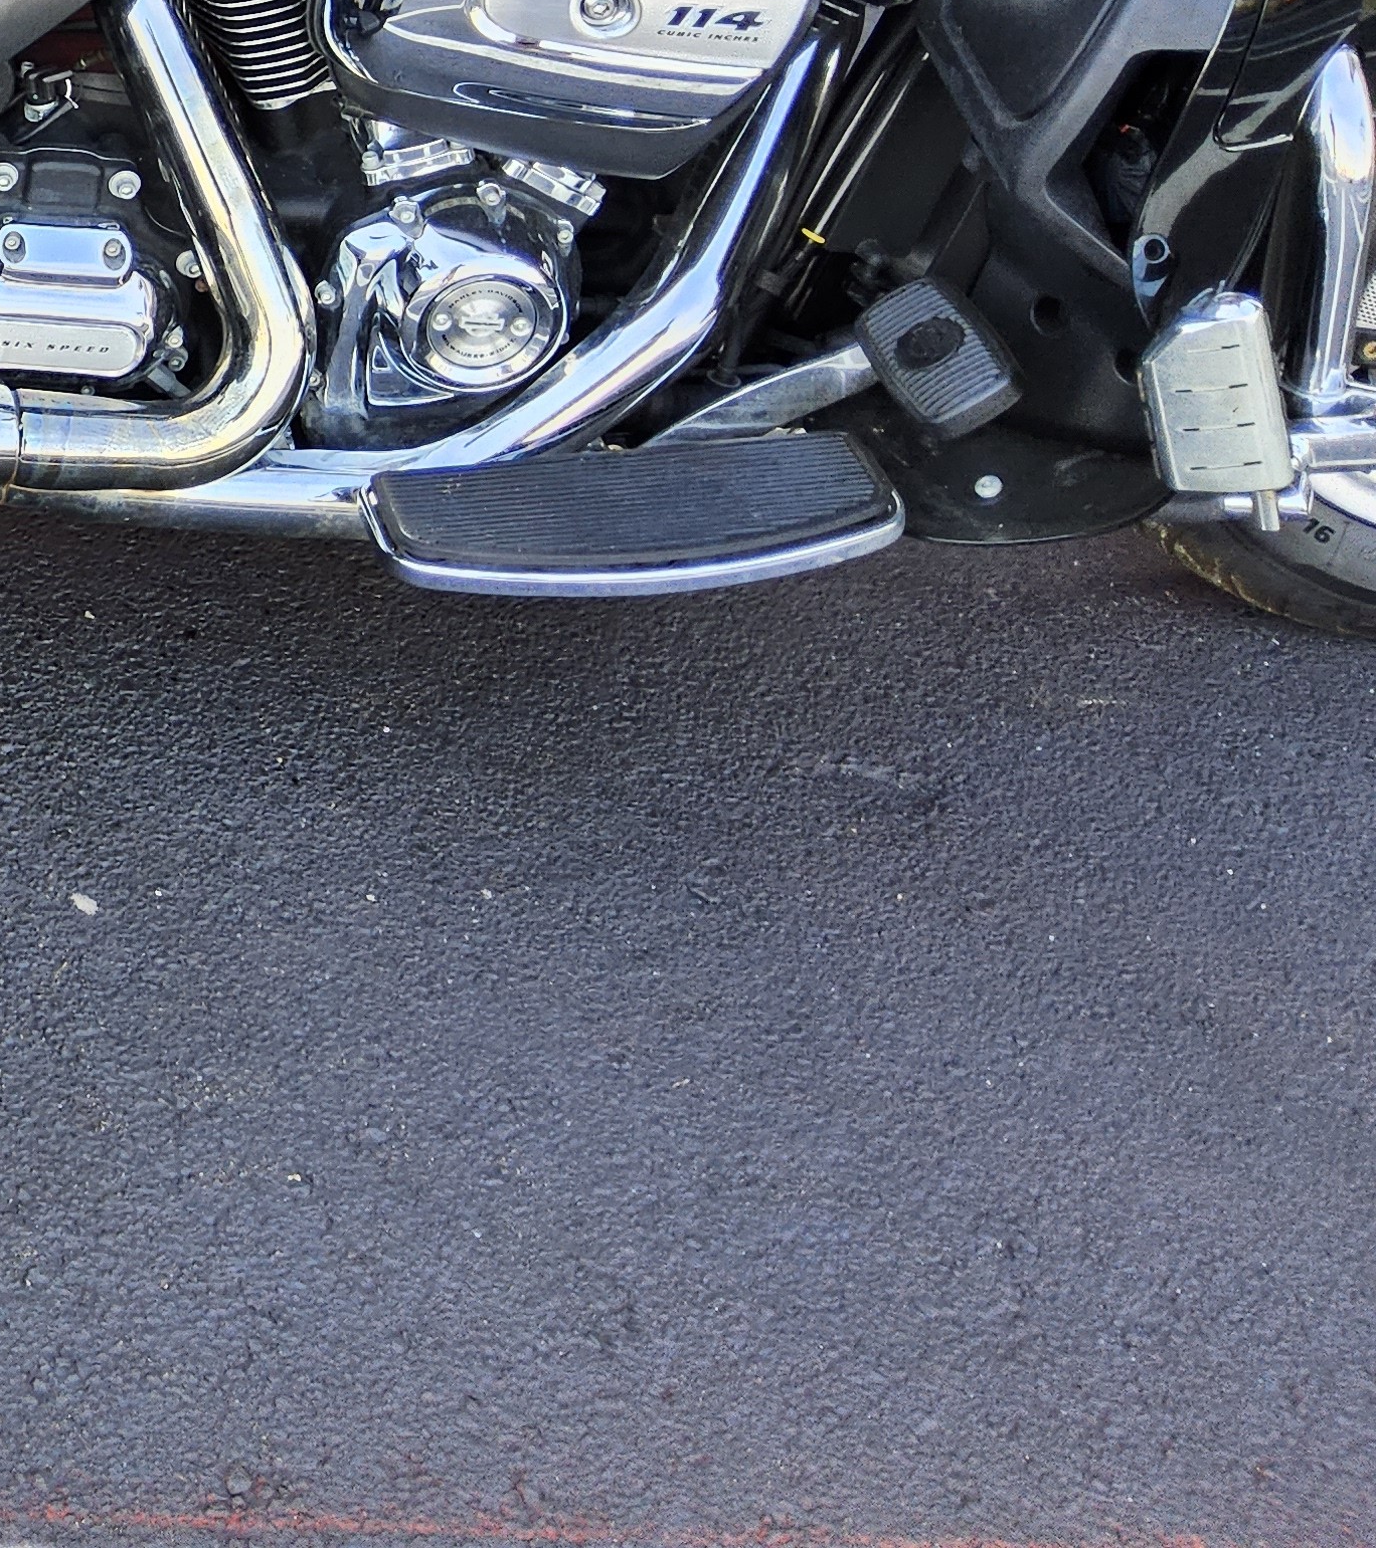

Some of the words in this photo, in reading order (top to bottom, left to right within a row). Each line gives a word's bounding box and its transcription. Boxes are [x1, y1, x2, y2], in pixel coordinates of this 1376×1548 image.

[667, 6, 765, 31] 114
[657, 29, 702, 38] CUBIC
[708, 33, 759, 42] INCHES
[1, 340, 35, 349] SIX
[45, 342, 110, 354] SPEED
[1303, 517, 1336, 544] 16
